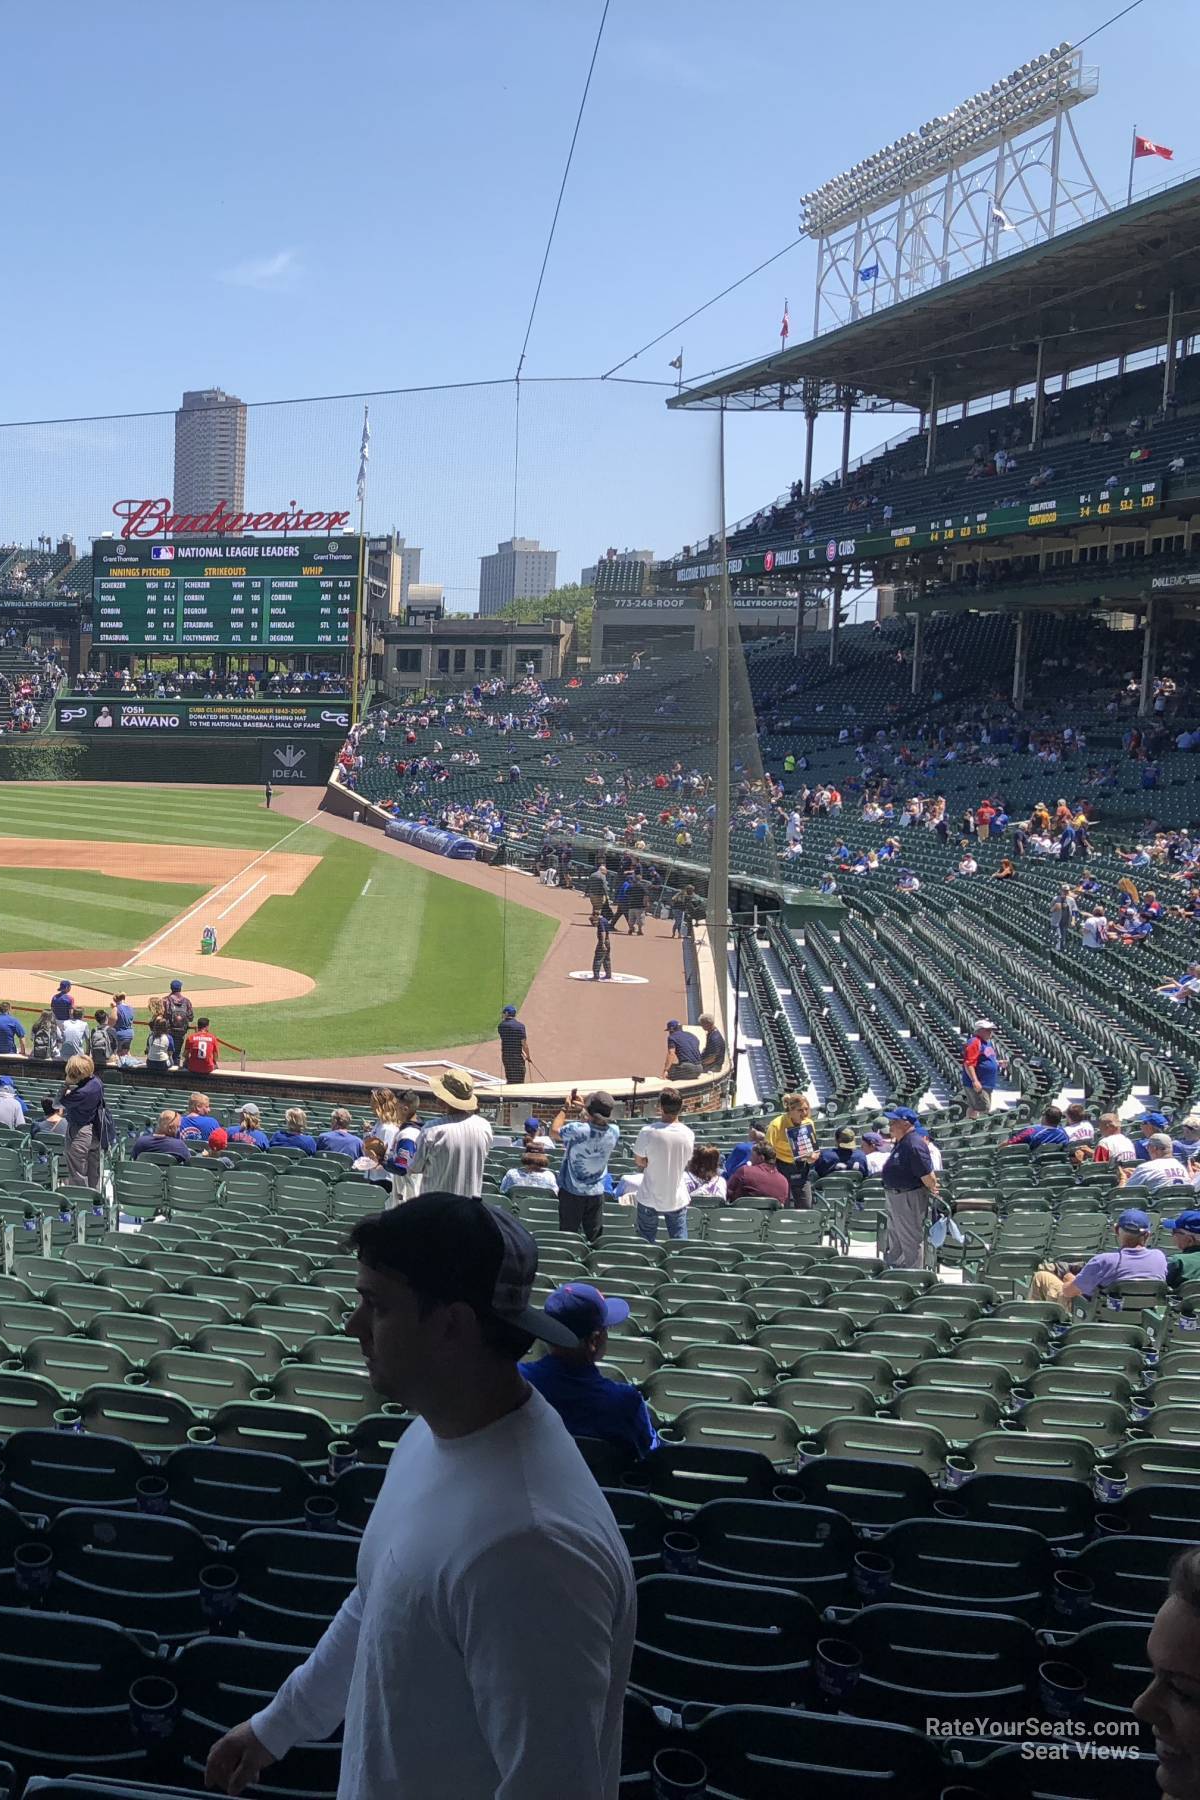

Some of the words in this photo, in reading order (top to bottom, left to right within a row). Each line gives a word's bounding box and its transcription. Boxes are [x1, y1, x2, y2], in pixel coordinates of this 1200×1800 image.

[1141, 495, 1154, 507] 1.73
[112, 498, 350, 537] Budweiser
[178, 546, 224, 558] NATIONAL
[225, 546, 259, 557] LEAGUE
[261, 546, 300, 557] LEADERS
[775, 549, 800, 567] PHILLIES
[838, 540, 856, 556] CUBS
[204, 567, 247, 576] STRIKEOUTS
[302, 566, 323, 575] WHIP
[728, 559, 742, 574] FIELD
[110, 568, 140, 576] INNINGS
[141, 568, 171, 576] PITCHED
[121, 706, 144, 714] YOSH
[120, 716, 180, 727] KAWANO
[272, 769, 307, 778] IDEAL
[1164, 1168, 1186, 1178] BAEZ
